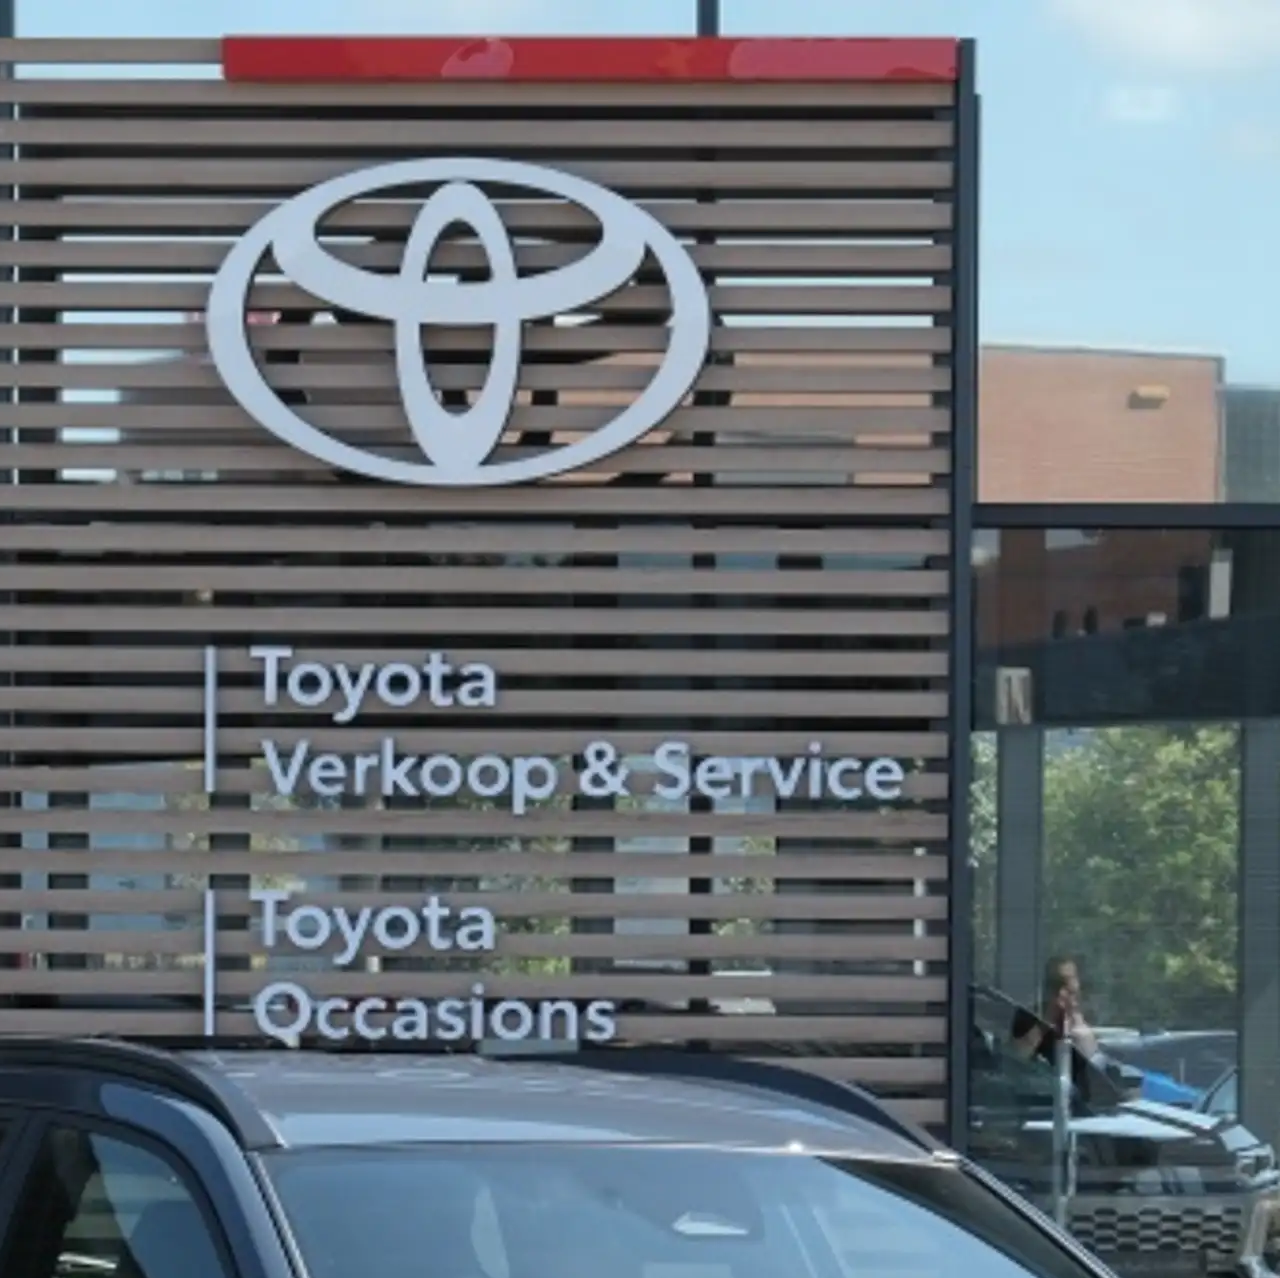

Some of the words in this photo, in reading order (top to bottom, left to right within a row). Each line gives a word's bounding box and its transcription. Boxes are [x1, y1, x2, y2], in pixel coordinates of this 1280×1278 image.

[250, 646, 496, 721] Toyota
[261, 738, 557, 815] Verkoop
[580, 741, 629, 800] &
[652, 740, 904, 800] Service
[250, 888, 496, 965] Toyota
[253, 982, 616, 1046] Occasions
